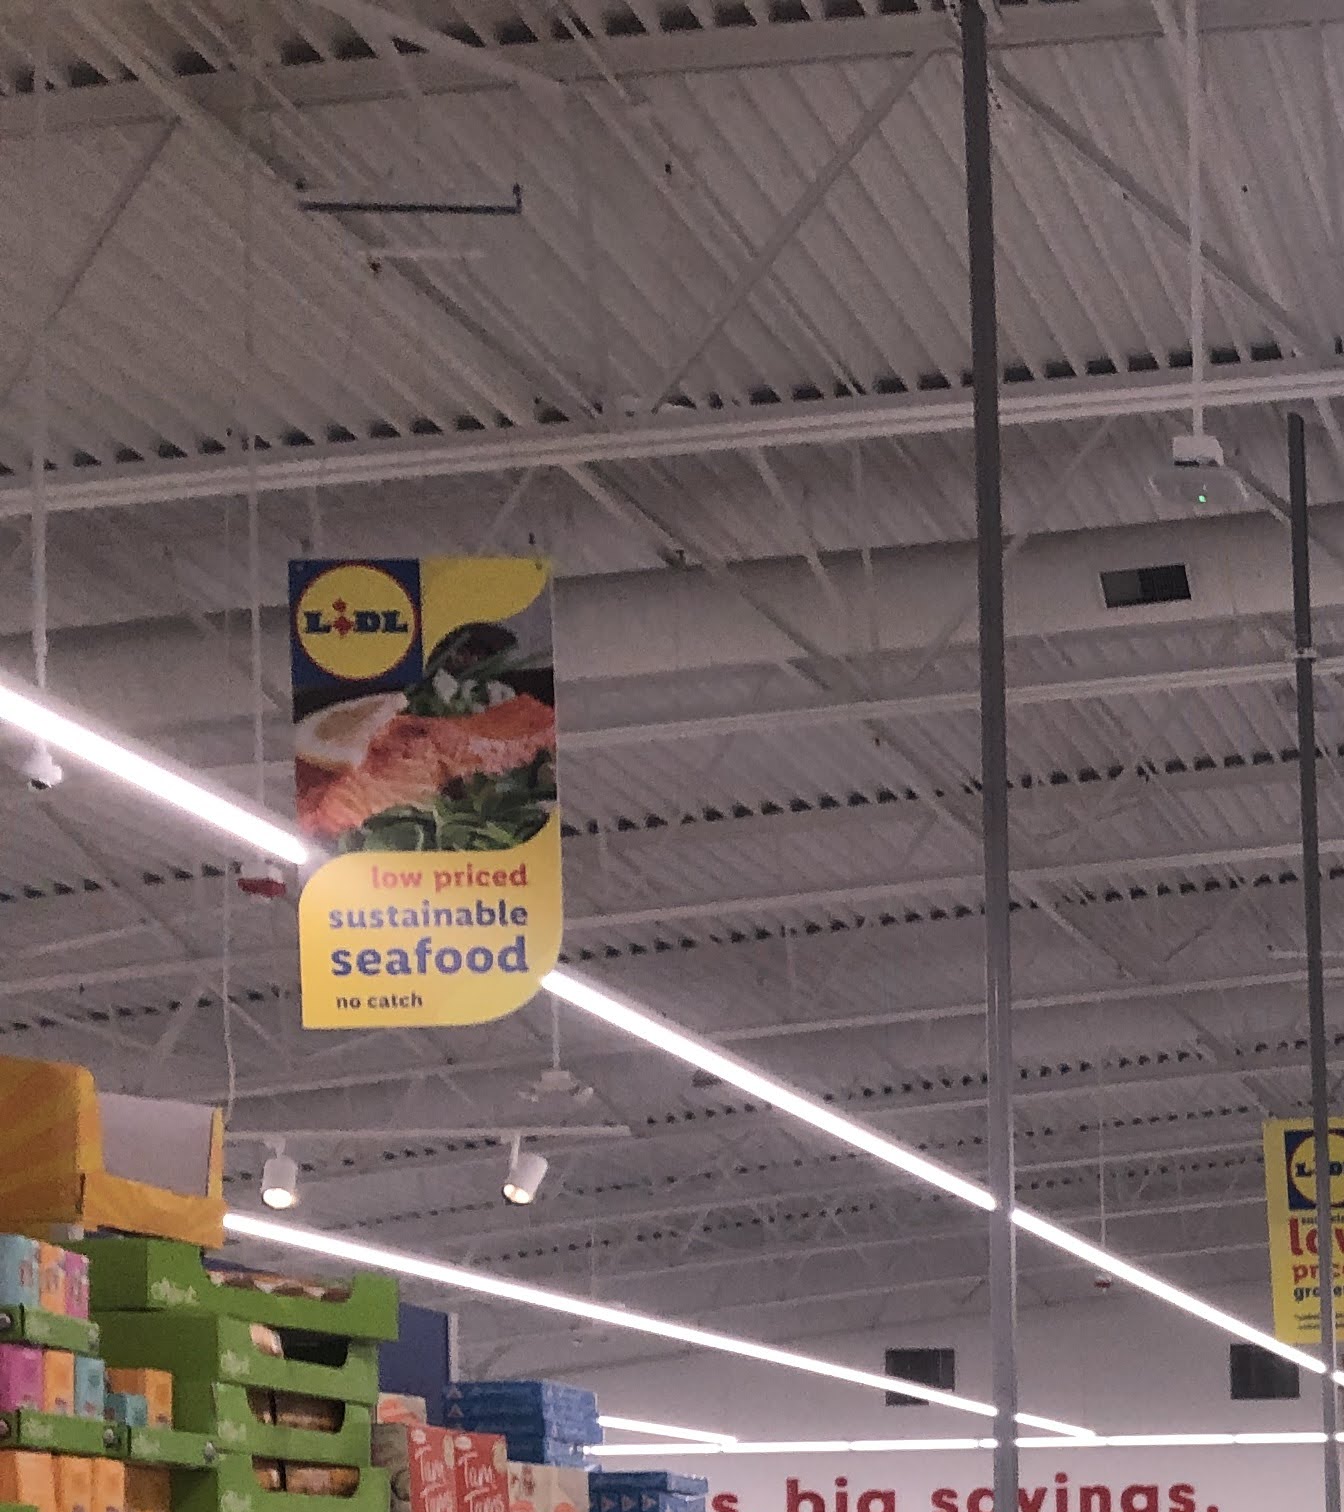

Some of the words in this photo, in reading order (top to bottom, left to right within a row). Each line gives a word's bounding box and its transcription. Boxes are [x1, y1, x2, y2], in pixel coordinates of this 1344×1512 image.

[371, 865, 423, 889] low
[434, 863, 528, 893] priced
[328, 899, 528, 929] sustainable
[331, 935, 529, 977] seafood
[335, 996, 369, 1010] no
[376, 991, 424, 1010] catch
